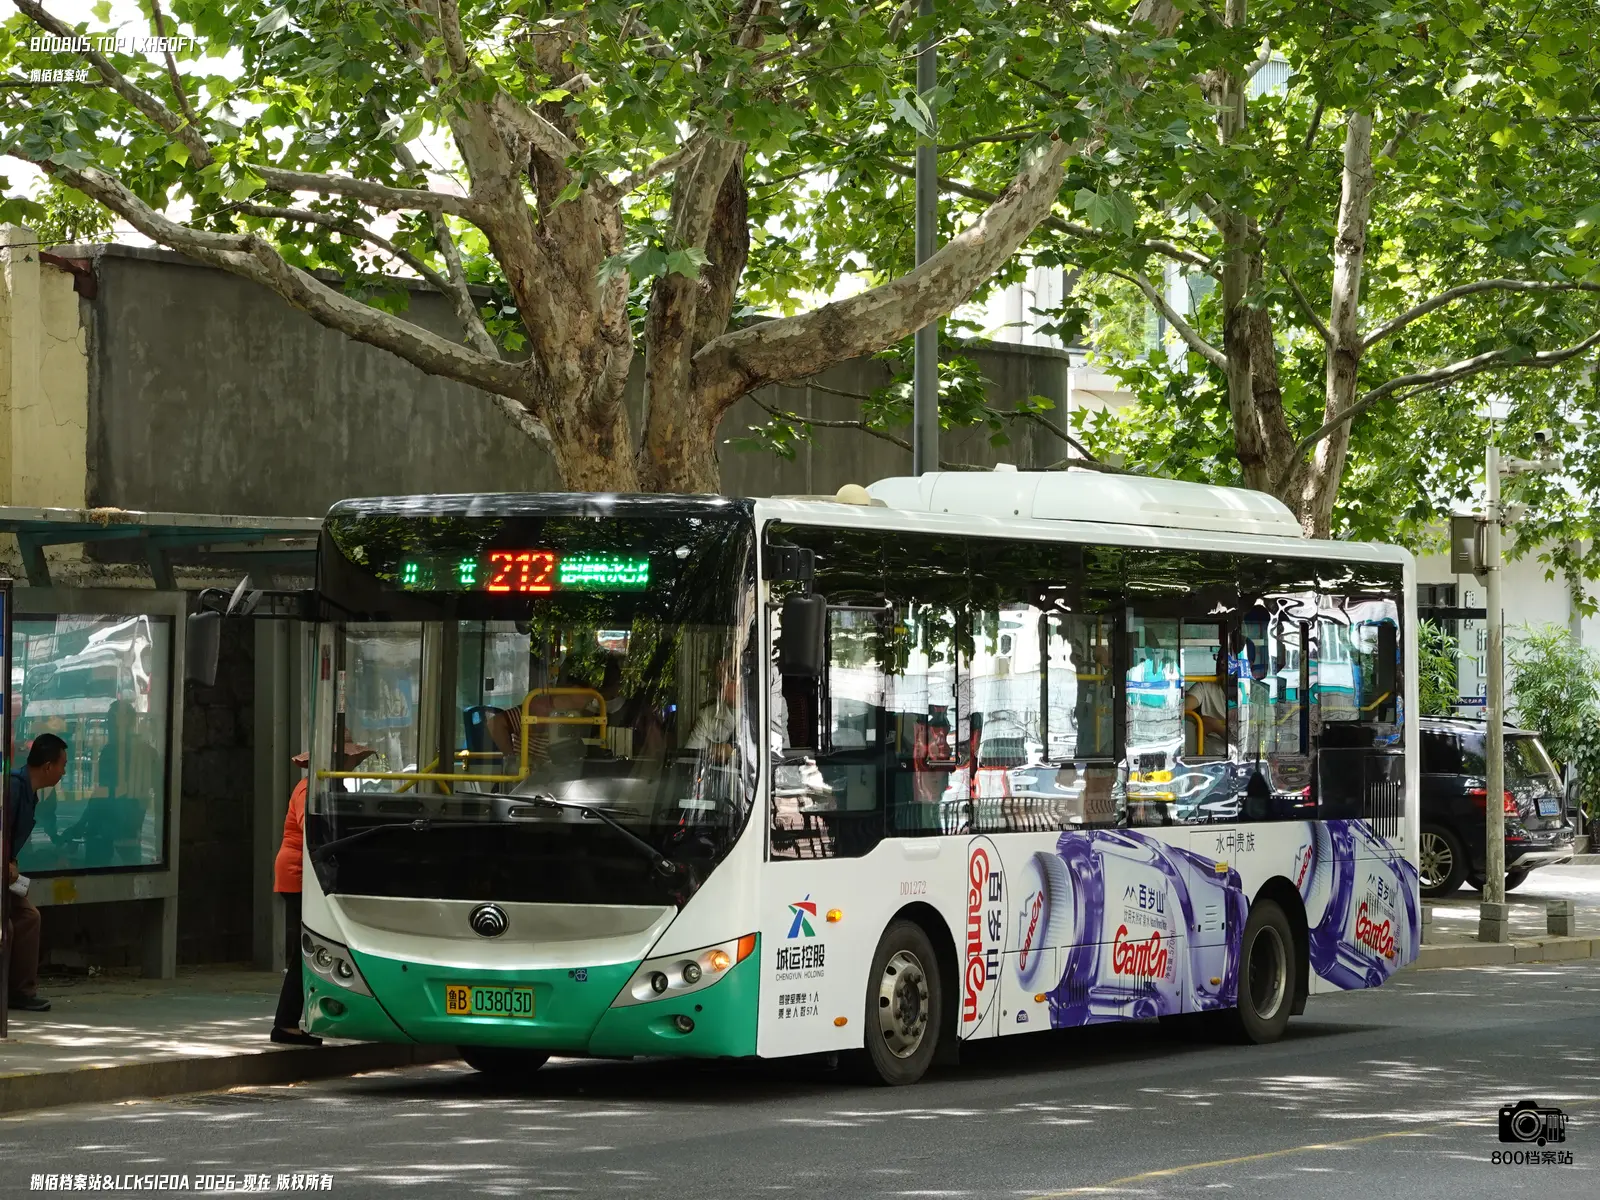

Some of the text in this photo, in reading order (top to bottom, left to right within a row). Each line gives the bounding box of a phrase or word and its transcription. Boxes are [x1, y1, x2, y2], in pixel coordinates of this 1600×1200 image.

[488, 553, 553, 592] 212
[1215, 832, 1256, 855] 水中贵族
[900, 881, 927, 895] DD1272
[1139, 884, 1164, 914] 百岁山
[985, 870, 1002, 980] 百岁山
[776, 944, 825, 972] 城运控股
[776, 970, 825, 982] CHENGYUN HOLDING
[475, 990, 532, 1013] 03803D
